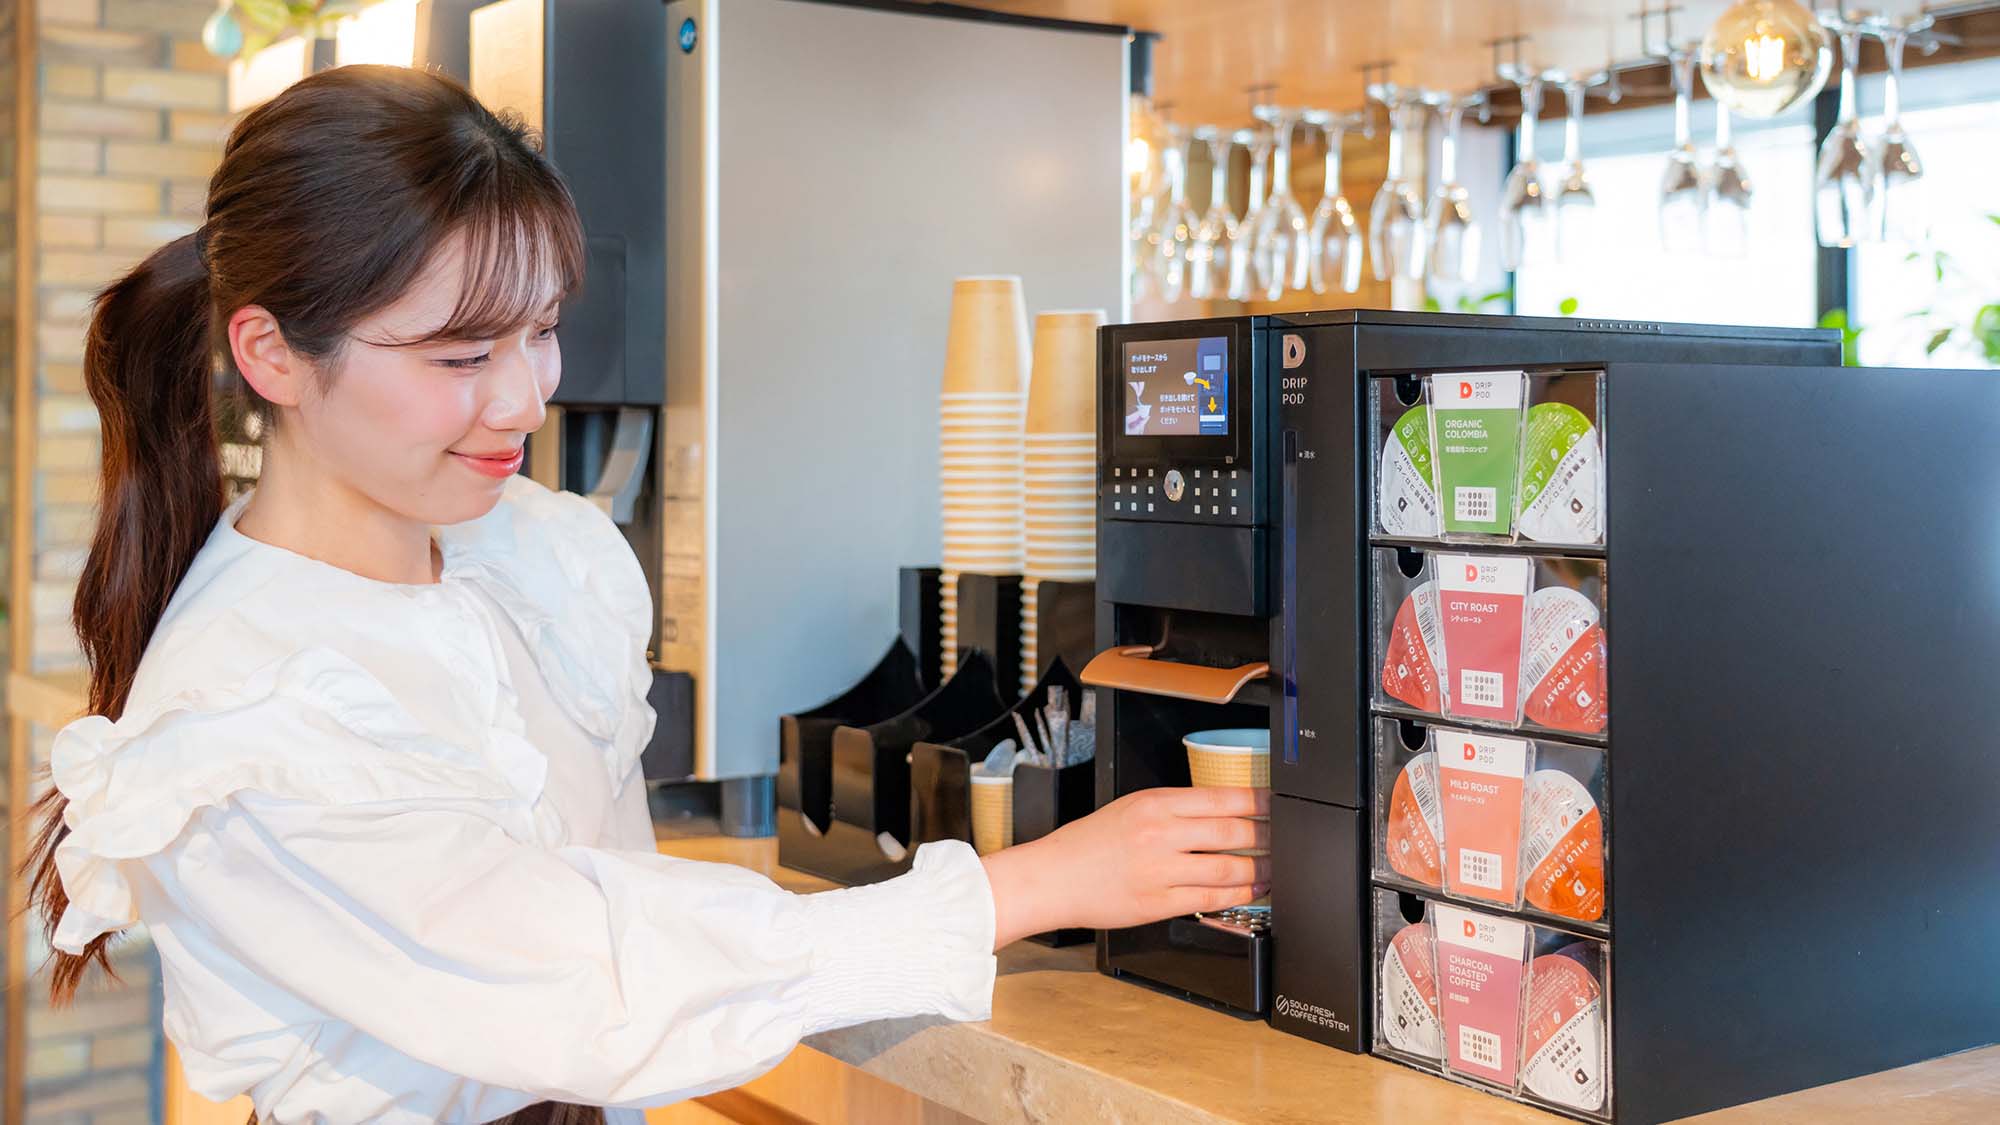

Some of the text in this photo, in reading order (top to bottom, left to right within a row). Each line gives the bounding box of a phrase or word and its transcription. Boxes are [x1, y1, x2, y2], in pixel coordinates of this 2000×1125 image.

[1282, 378, 1307, 389] DRIP
[1282, 394, 1304, 404] POD
[1445, 420, 1482, 428] ORGANIC
[1445, 430, 1488, 438] COLOMBIA
[1450, 602, 1498, 613] CITY ROAST
[1450, 615, 1482, 624] シティロースト
[1401, 625, 1419, 661] ROAST
[1569, 650, 1593, 676] CITY
[1414, 665, 1431, 692] CITY
[1542, 674, 1570, 707] ROAST
[1450, 780, 1500, 794] MILD ROAST
[1400, 800, 1435, 868] MILD ROAST
[1564, 837, 1589, 864] MILD
[1540, 862, 1568, 893] ROAST
[1450, 955, 1494, 974] CHARCOAL
[1450, 964, 1488, 982] ROASTED
[1450, 976, 1480, 992] COFFEE
[1290, 1000, 1335, 1019] SOLO FRESH
[1290, 1009, 1350, 1032] COFFEE SYSTEM
